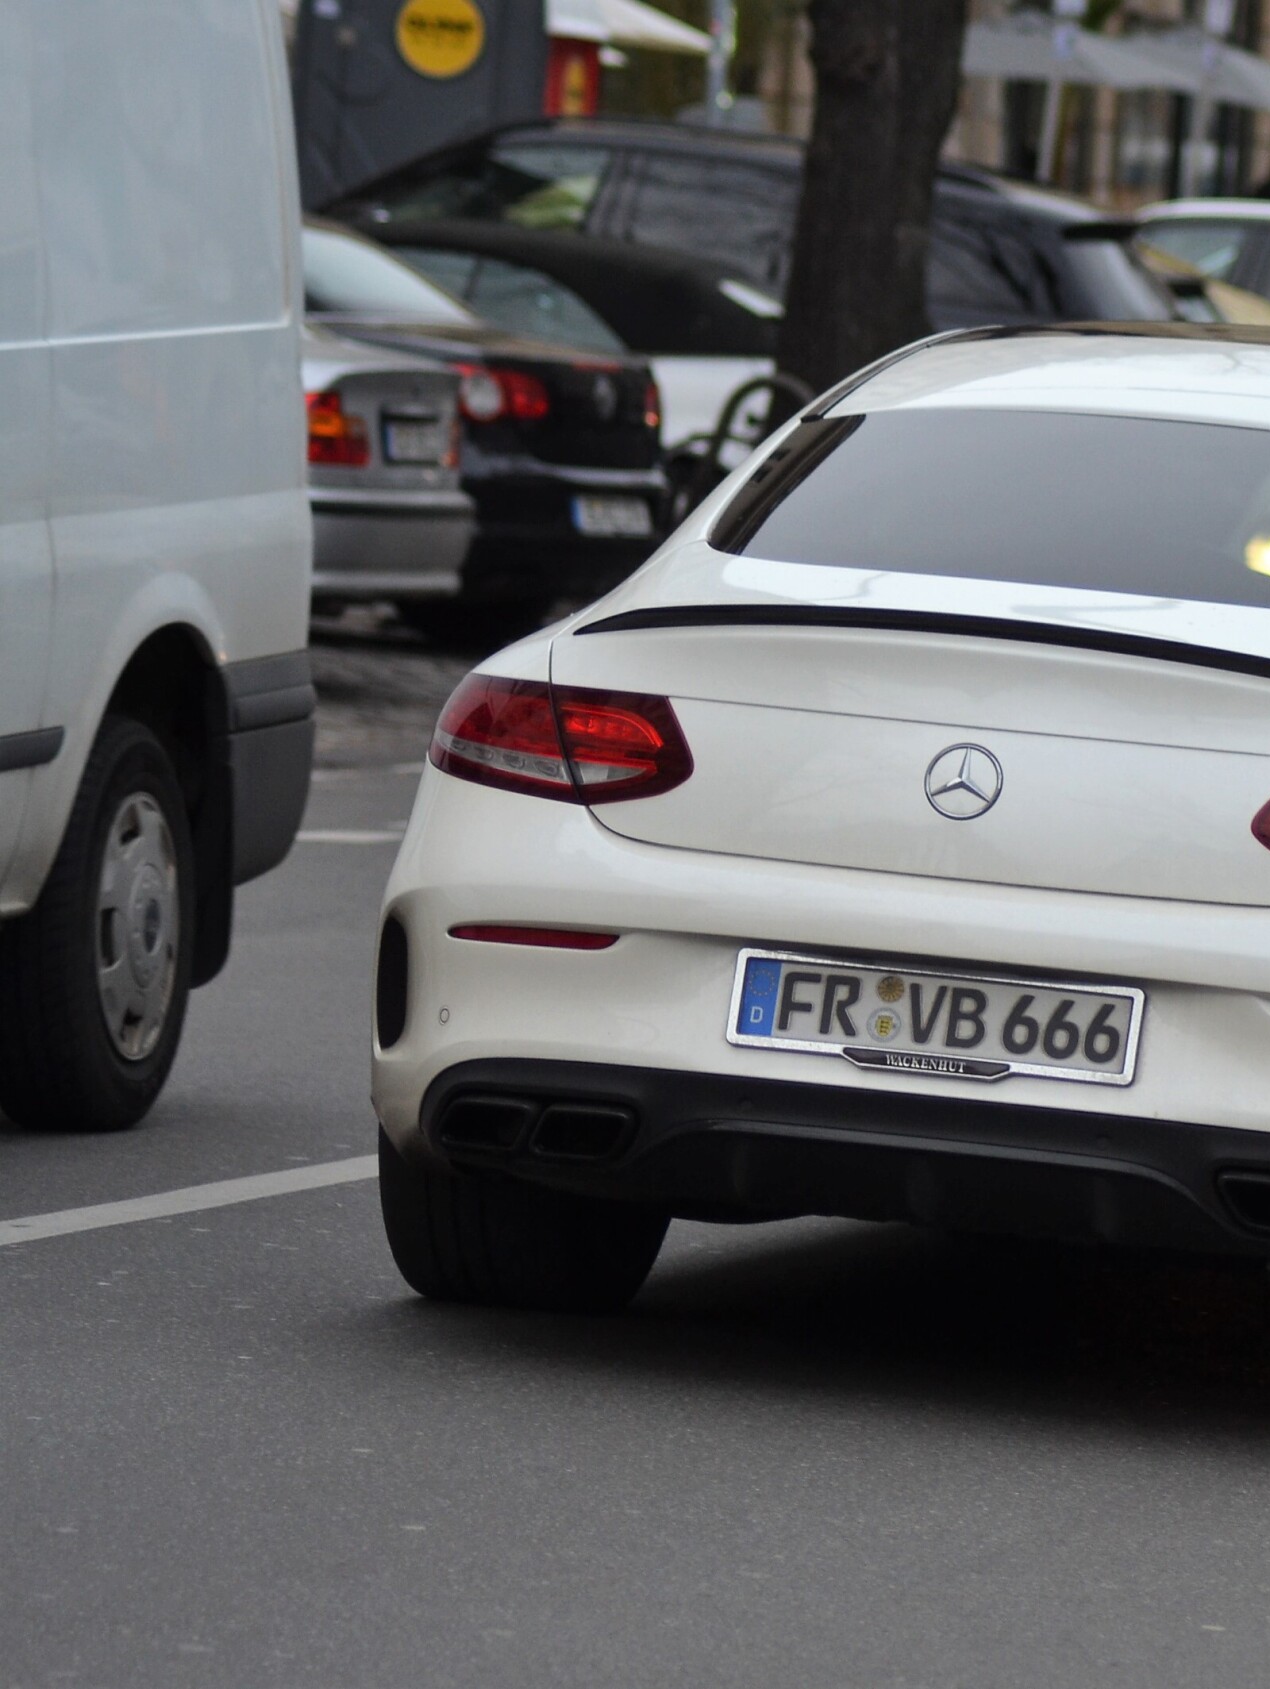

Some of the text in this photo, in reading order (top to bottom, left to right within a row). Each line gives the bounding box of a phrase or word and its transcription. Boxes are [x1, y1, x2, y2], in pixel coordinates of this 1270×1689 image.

[777, 971, 1120, 1064] FR VB 666
[885, 1054, 966, 1073] WACKENHUT
